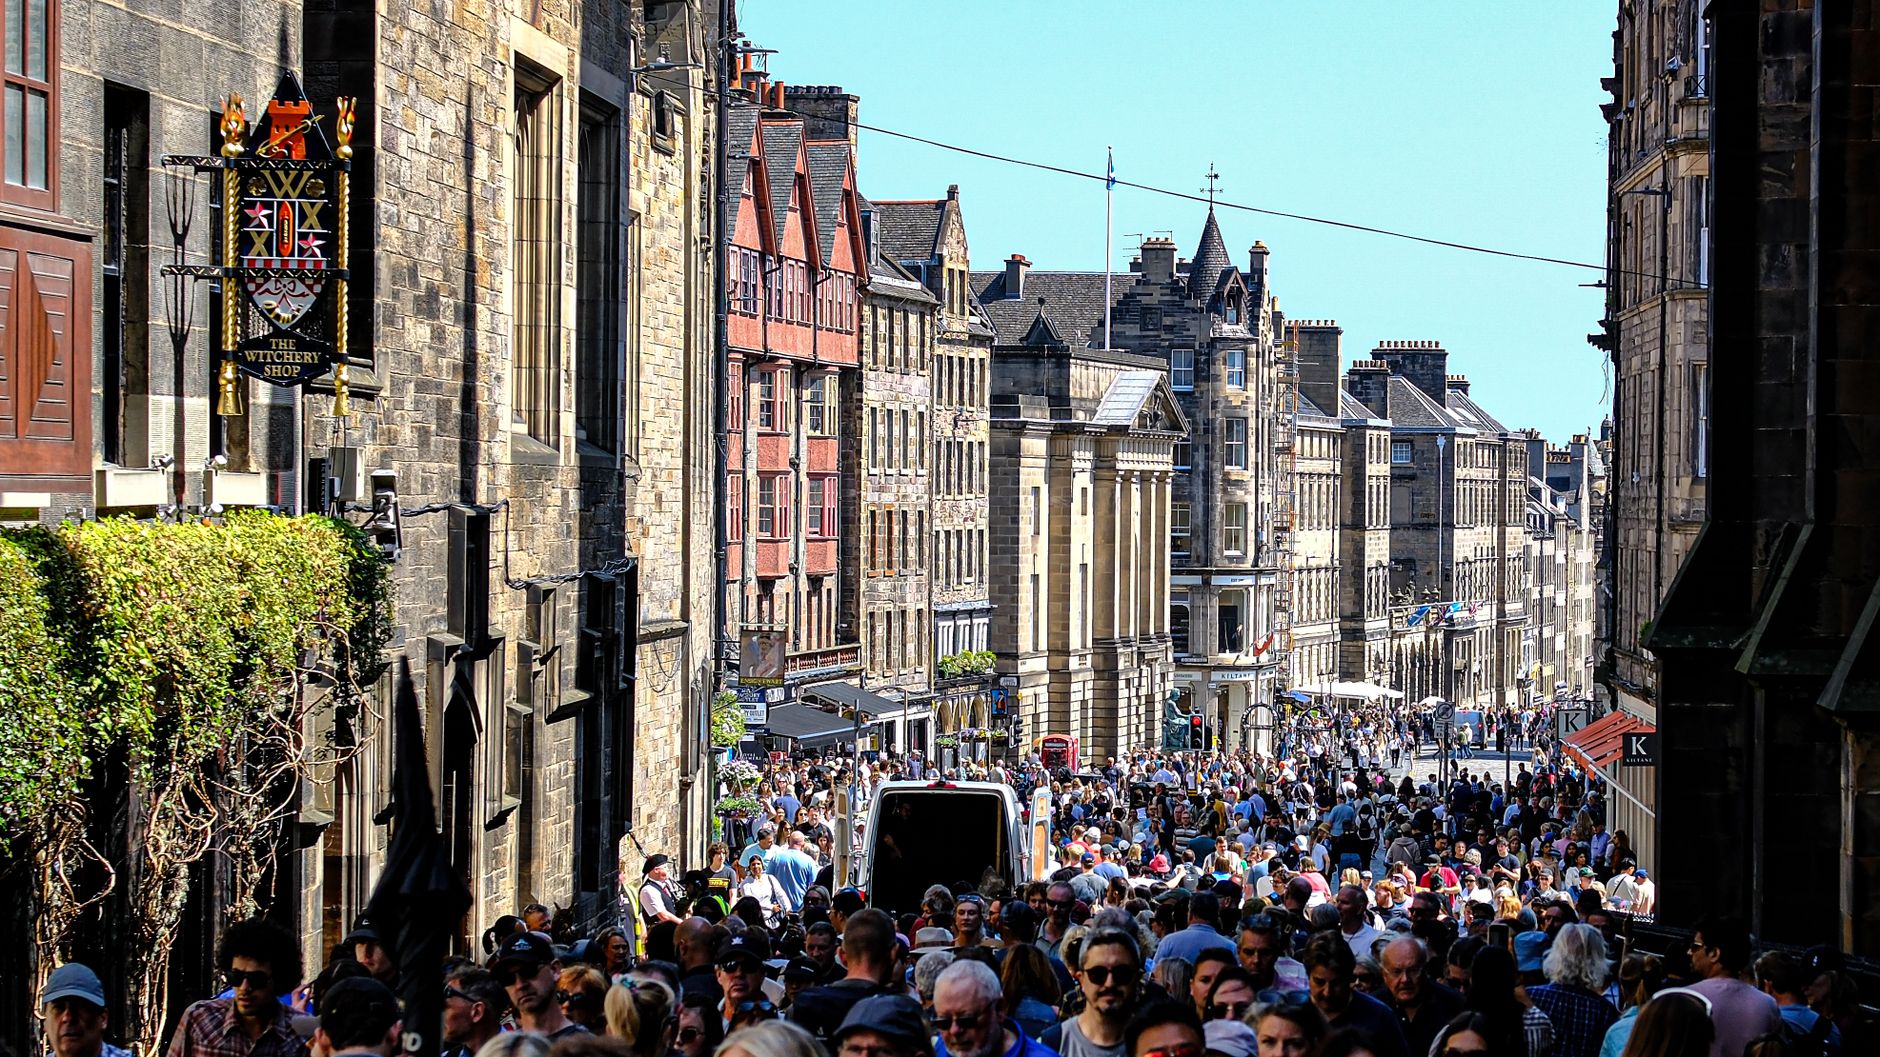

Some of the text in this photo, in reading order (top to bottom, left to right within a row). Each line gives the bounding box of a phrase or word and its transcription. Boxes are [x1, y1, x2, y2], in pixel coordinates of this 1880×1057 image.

[269, 338, 297, 350] THE
[243, 350, 322, 364] WITCHERY
[263, 364, 301, 377] SHOP
[1564, 712, 1580, 733] K
[1631, 736, 1647, 755] K
